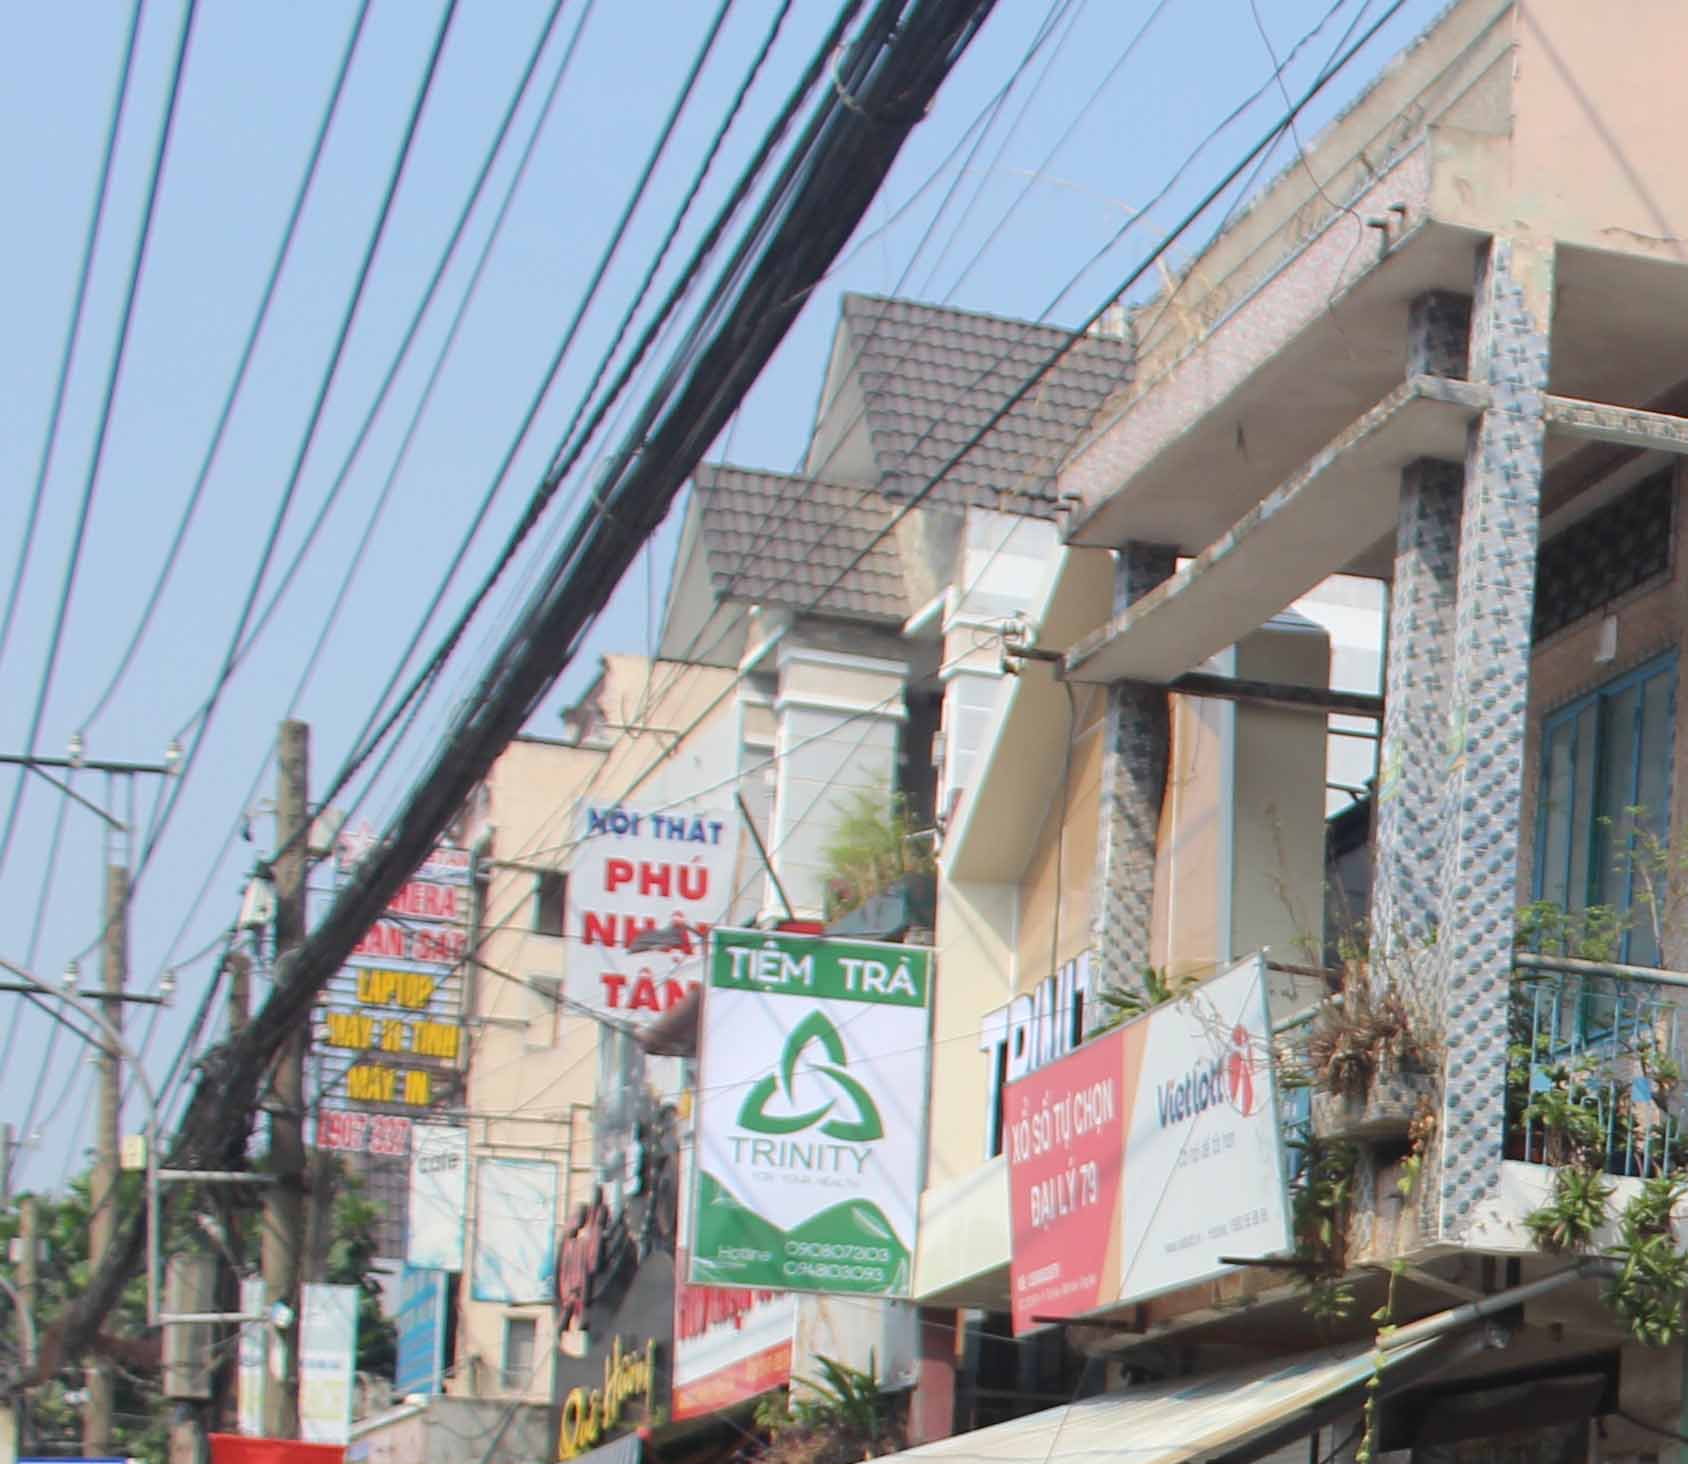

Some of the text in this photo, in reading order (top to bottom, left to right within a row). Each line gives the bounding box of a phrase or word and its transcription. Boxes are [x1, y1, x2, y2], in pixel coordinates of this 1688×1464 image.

[605, 855, 708, 900] PHÚ
[725, 942, 918, 997] TIỆM TRÀ
[1010, 1077, 1116, 1163] XỔ SỐ TỰ CHỌN
[728, 1135, 874, 1175] TRINITY
[1056, 1156, 1077, 1218] LÝ
[1078, 1159, 1099, 1207] 79
